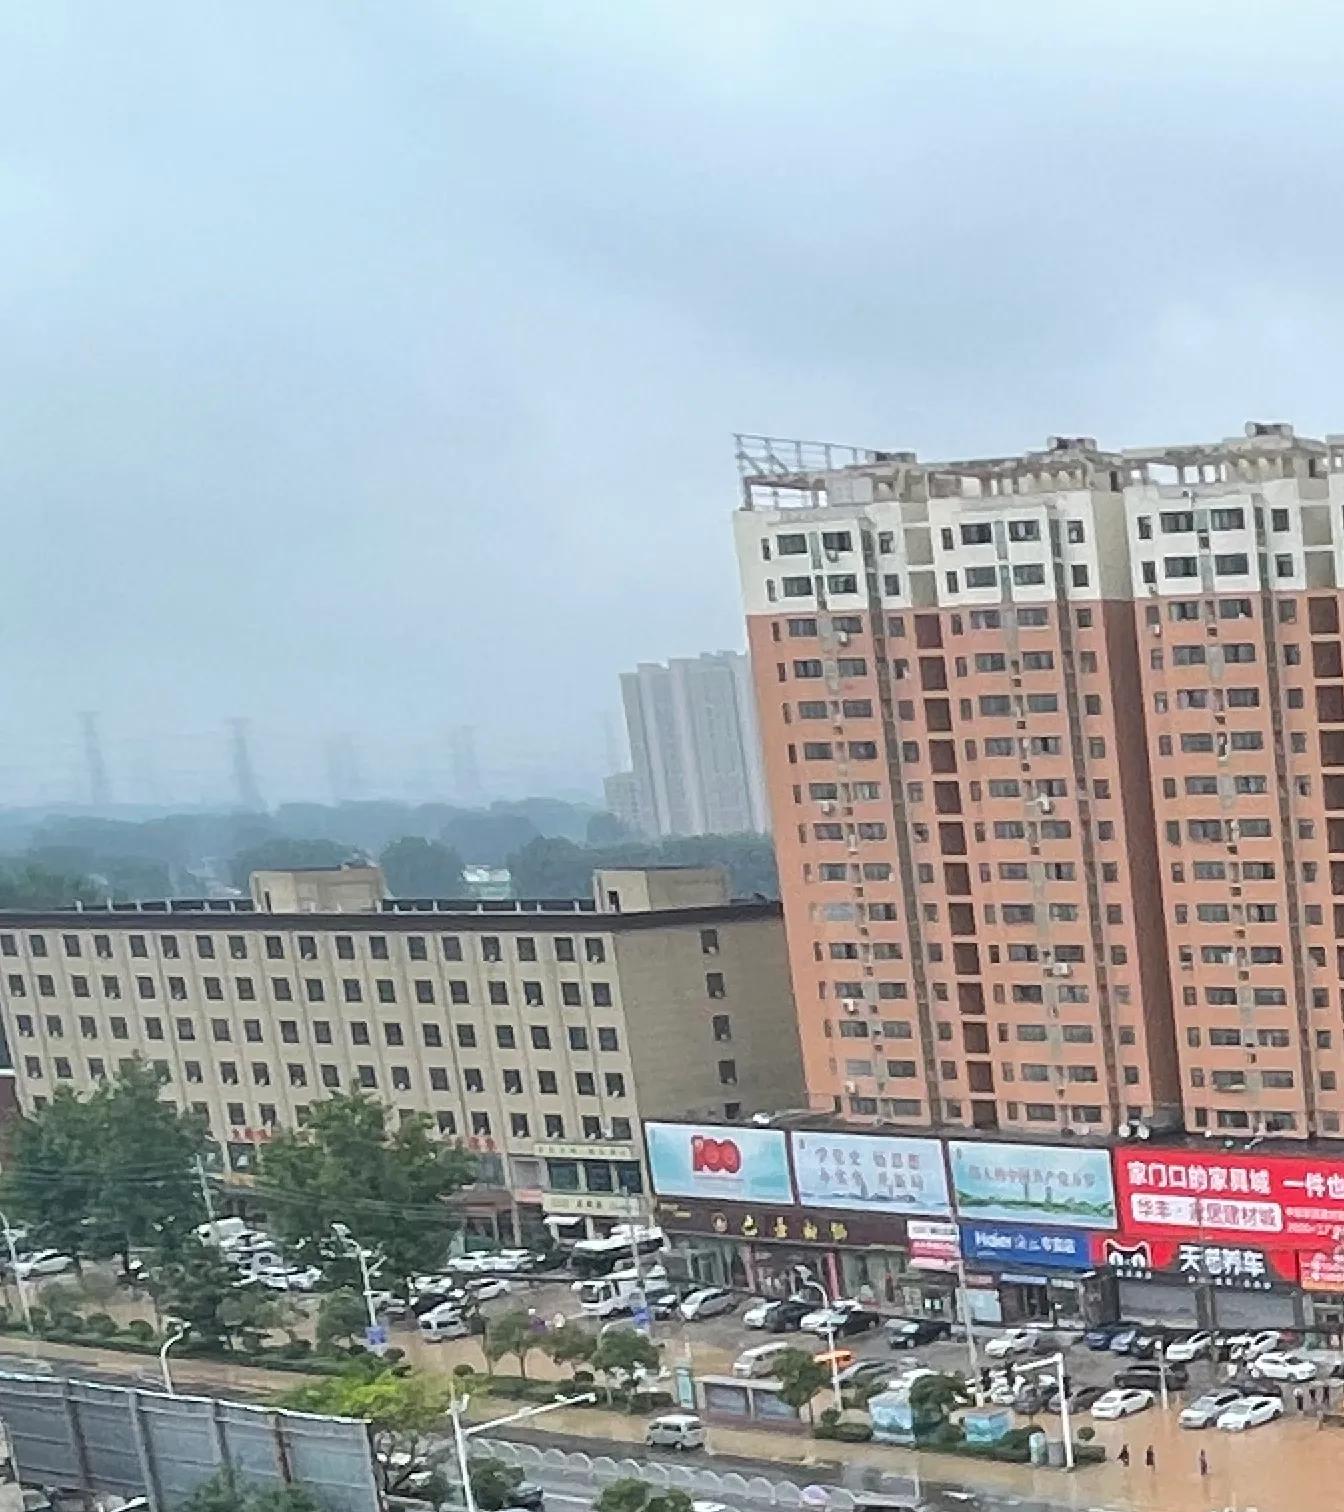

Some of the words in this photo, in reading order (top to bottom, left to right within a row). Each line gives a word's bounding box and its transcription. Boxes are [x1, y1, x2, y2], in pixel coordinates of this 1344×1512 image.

[1127, 1160, 1272, 1195] 家门口的家具城
